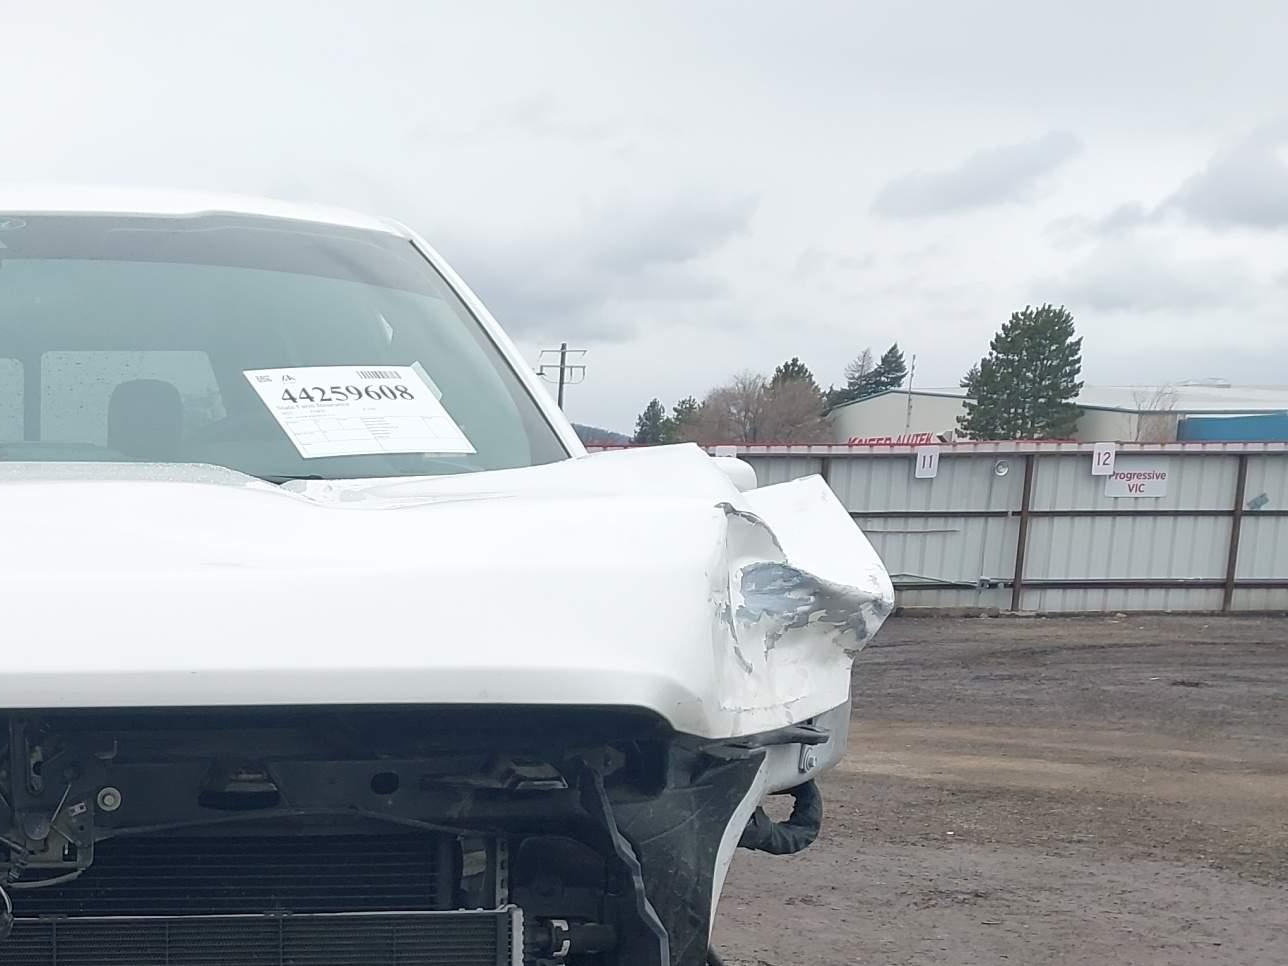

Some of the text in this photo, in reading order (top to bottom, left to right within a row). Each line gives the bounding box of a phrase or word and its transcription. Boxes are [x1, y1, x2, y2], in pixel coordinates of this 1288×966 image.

[281, 385, 415, 403] 44259608
[922, 455, 933, 469] 11
[1097, 452, 1111, 466] 12
[1109, 471, 1167, 482] Progressive
[1128, 483, 1145, 493] VIC
